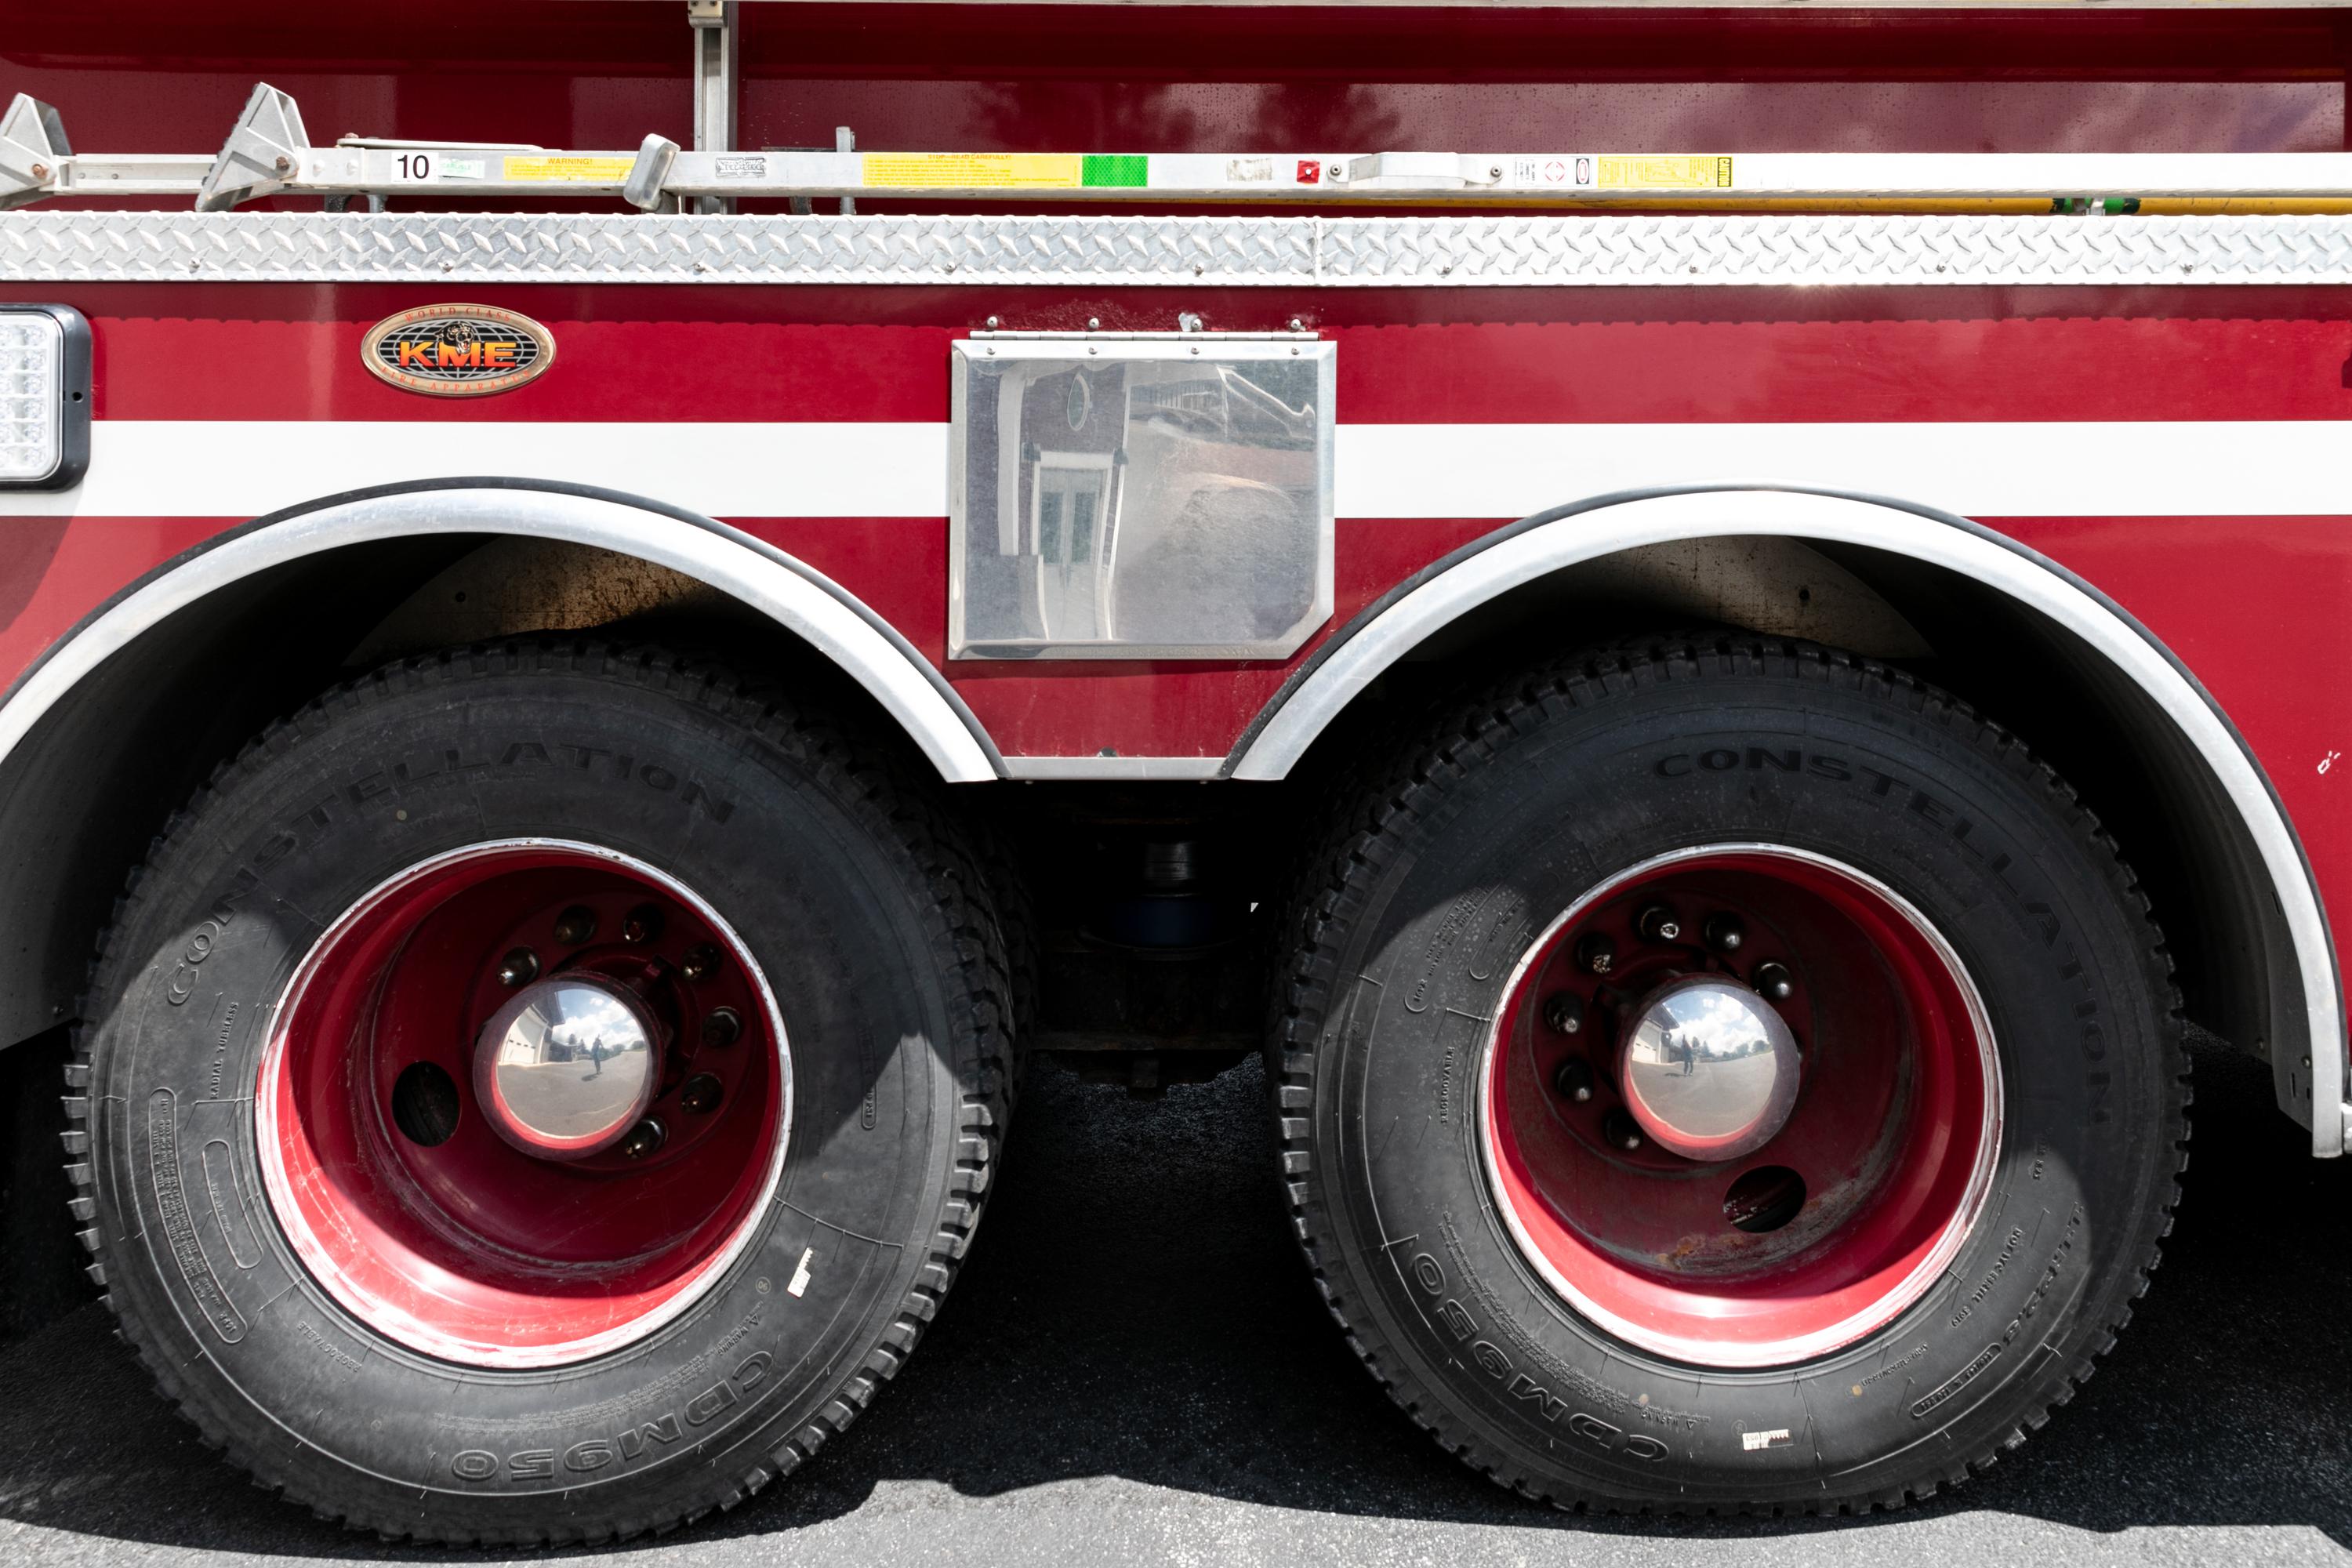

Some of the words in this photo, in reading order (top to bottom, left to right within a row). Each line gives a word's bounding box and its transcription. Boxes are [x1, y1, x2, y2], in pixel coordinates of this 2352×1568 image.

[397, 154, 429, 179] 10
[1719, 158, 1730, 187] CAUTION
[404, 307, 457, 322] WORLD
[466, 307, 511, 322] CLASS
[380, 366, 416, 387] FIRE
[430, 370, 531, 392] APPARATUS
[399, 340, 517, 368] KME
[167, 741, 735, 1007] CONSTELLATION
[1654, 746, 2111, 1126] CONSTELLATION
[214, 999, 239, 1054] TUBELESS
[209, 1059, 223, 1099] RADIAL
[1440, 1044, 1456, 1122] REGROOVABLE
[296, 1320, 363, 1373] REGROOVABLE
[1412, 1252, 1669, 1463] CDM950
[451, 1348, 776, 1481] CDM950
